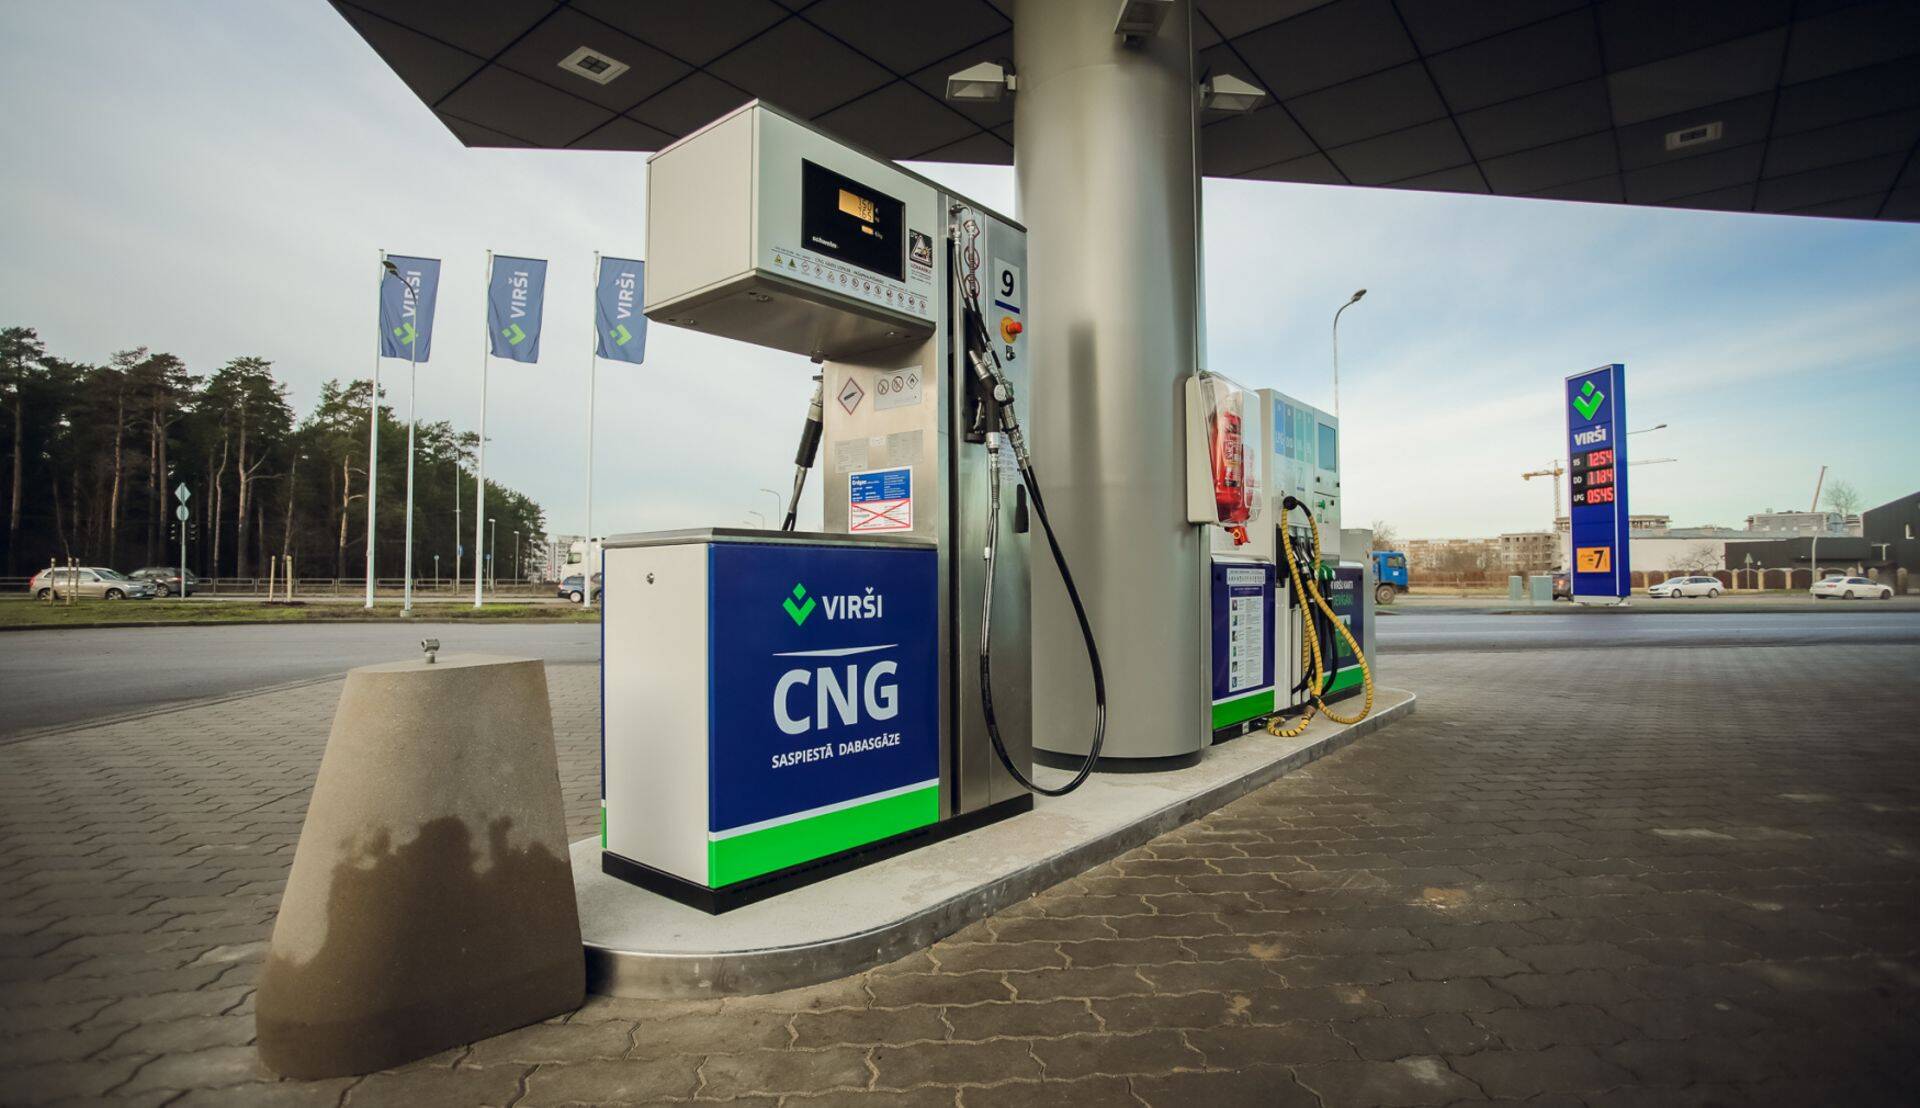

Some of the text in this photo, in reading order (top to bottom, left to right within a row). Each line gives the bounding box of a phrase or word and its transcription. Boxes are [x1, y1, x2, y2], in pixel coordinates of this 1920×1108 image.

[402, 270, 422, 317] VIRŠI
[508, 271, 529, 319] VIRŠI
[615, 273, 635, 319] VIRŠI
[1001, 270, 1014, 297] 9
[1574, 426, 1607, 446] VIRŠI
[1573, 493, 1585, 502] LPG
[822, 587, 883, 620] VIRŠI
[773, 660, 899, 735] CNG
[771, 732, 901, 769] SASPIESTĀ DABASGĀZE
